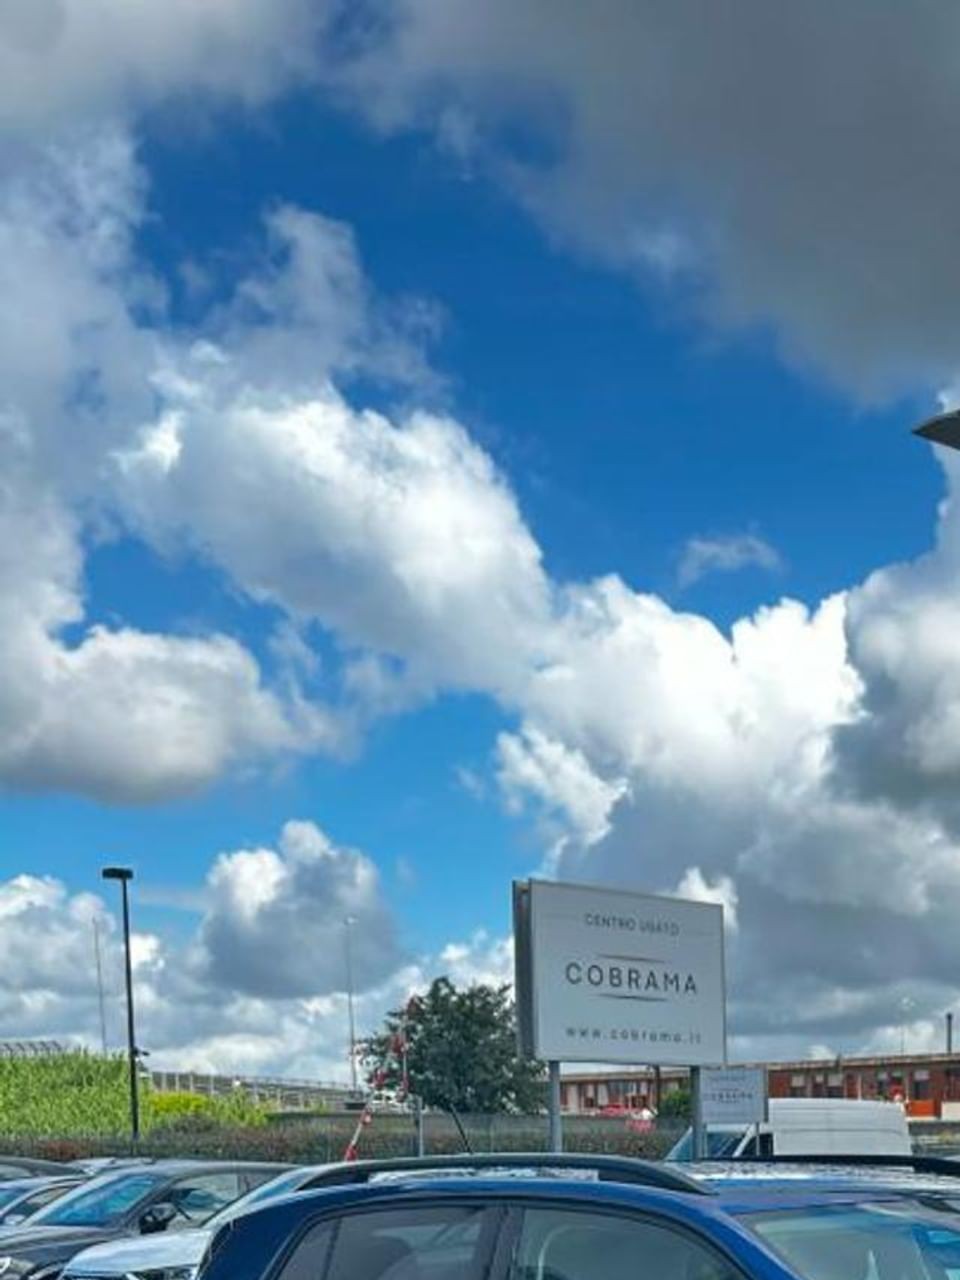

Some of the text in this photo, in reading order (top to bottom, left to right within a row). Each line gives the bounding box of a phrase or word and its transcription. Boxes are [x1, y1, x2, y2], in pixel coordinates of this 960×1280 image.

[584, 912, 681, 937] CENTRO USATO
[564, 961, 698, 995] COBRAMA
[565, 1026, 702, 1045] www.cobrama.it
